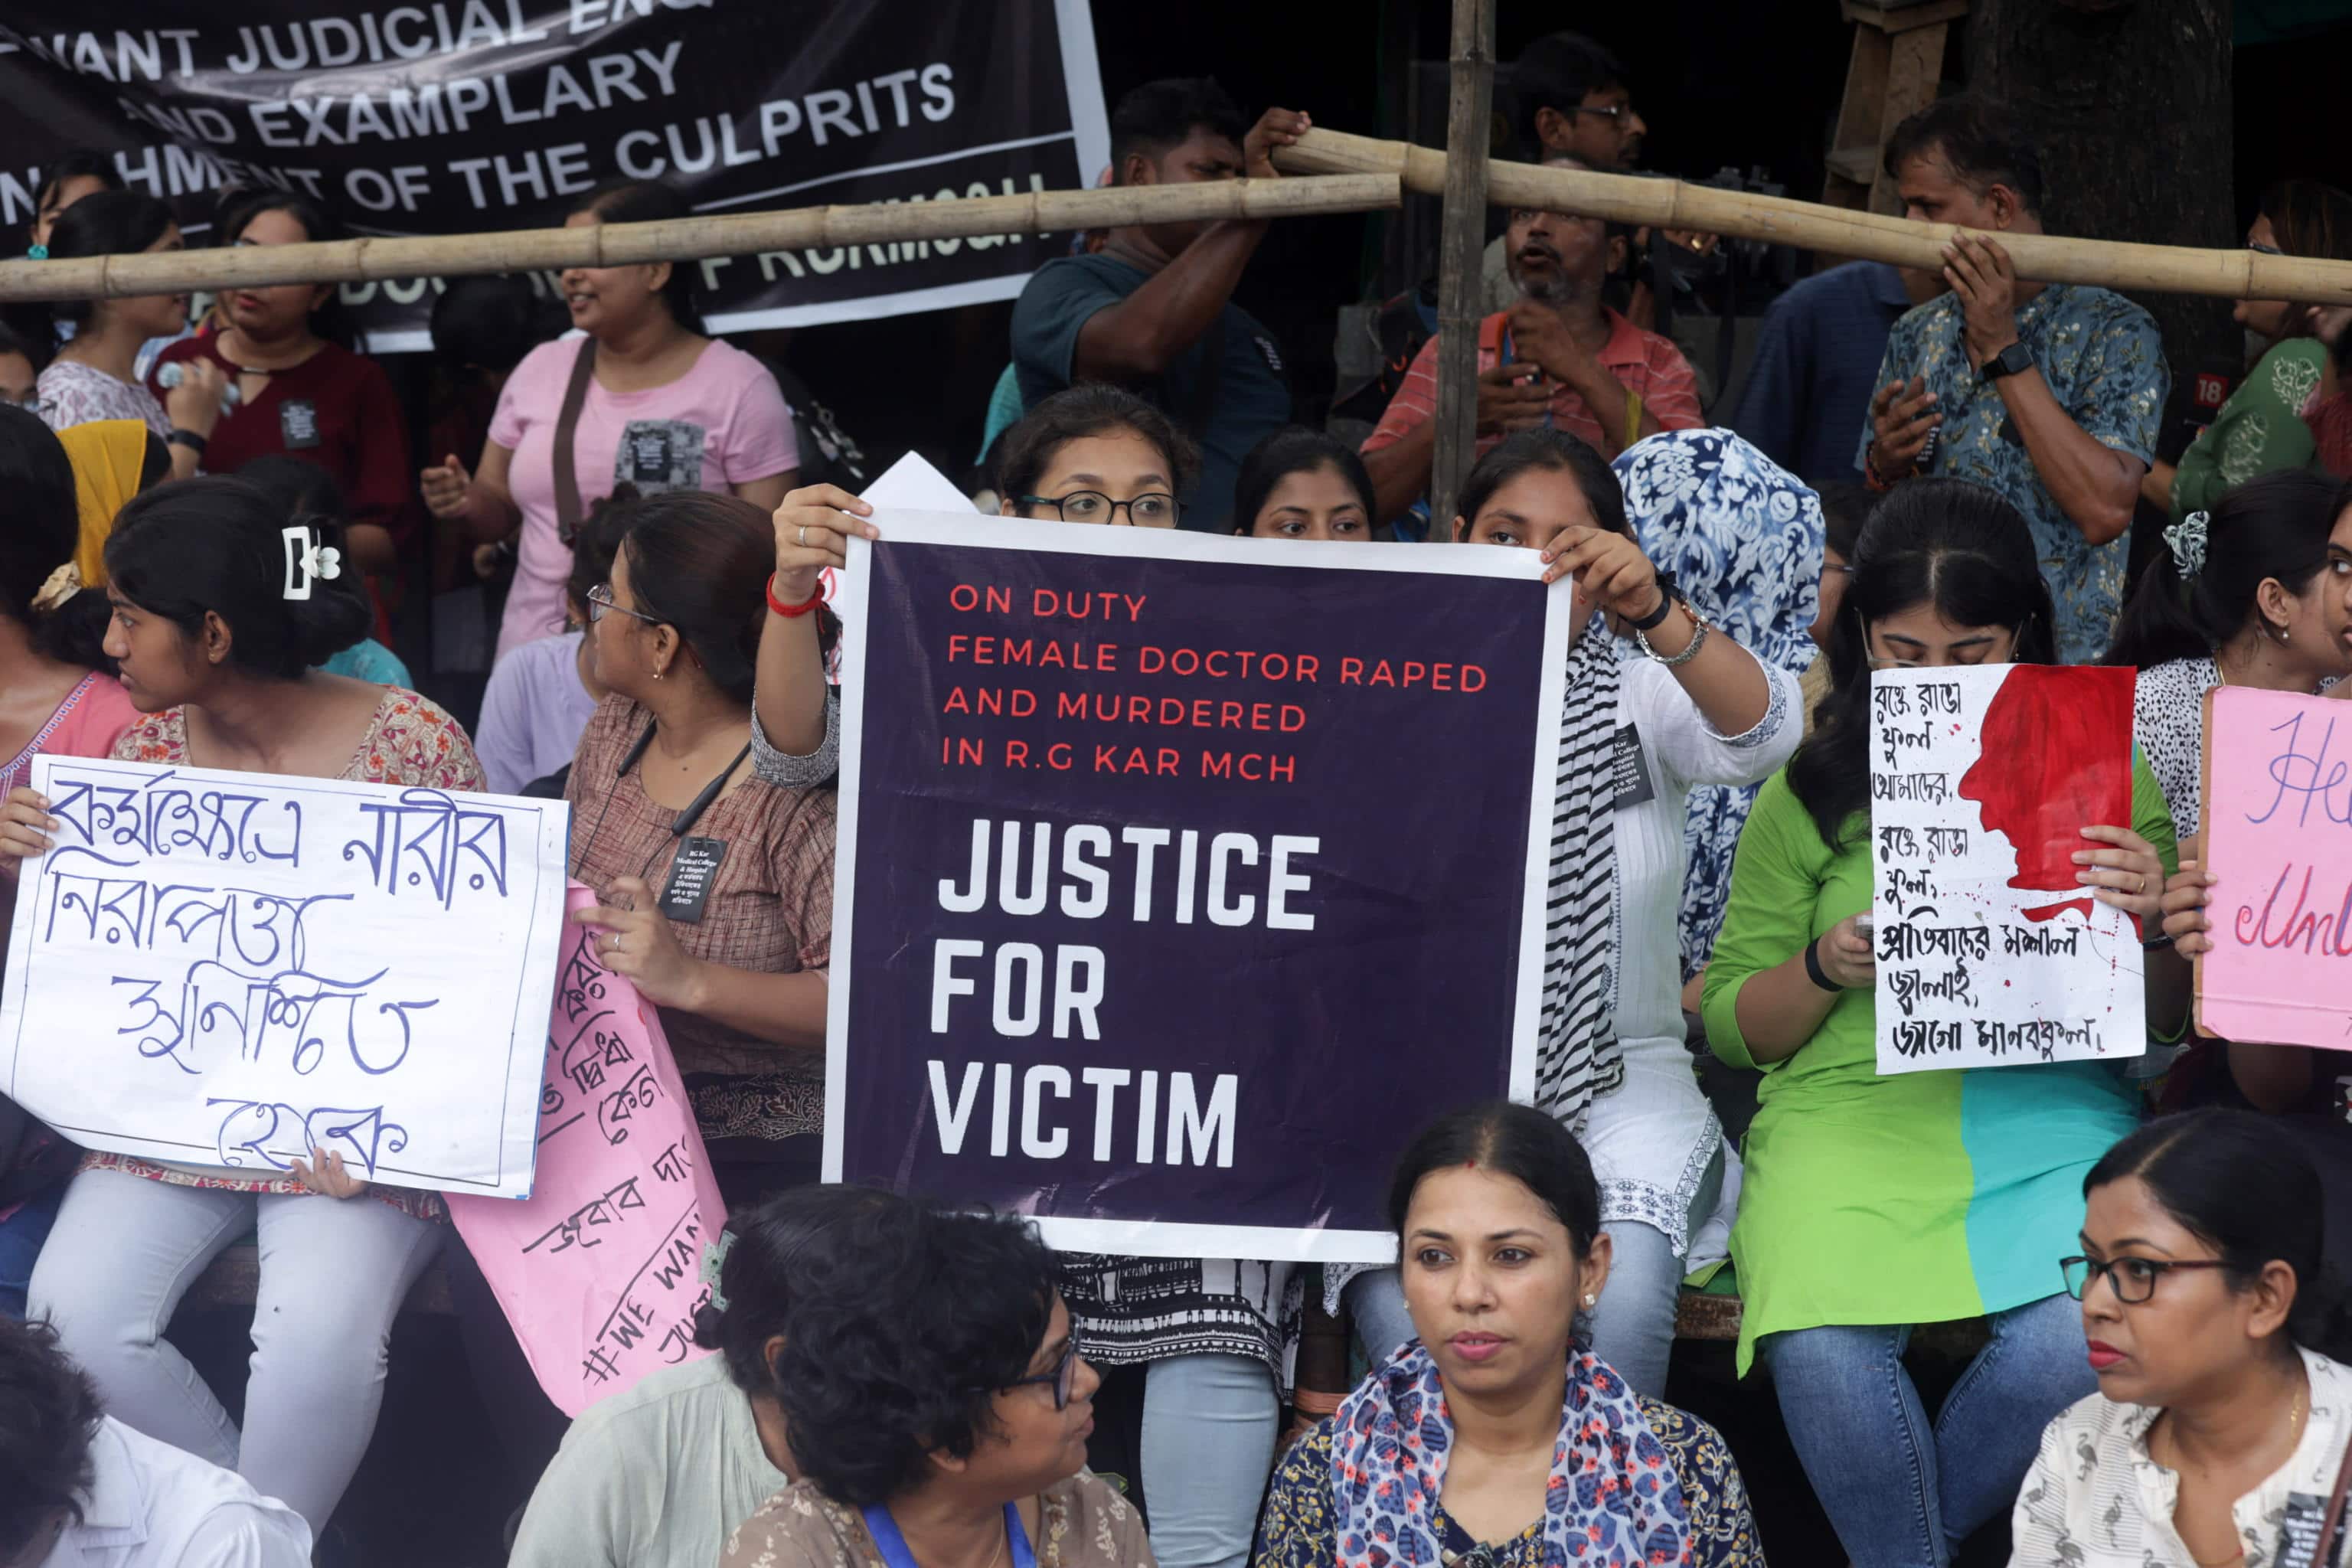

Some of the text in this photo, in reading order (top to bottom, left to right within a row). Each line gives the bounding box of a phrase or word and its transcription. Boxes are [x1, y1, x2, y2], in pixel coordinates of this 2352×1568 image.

[227, 0, 548, 74] JUDICIAL
[249, 41, 682, 148] EXAMPLARY
[345, 165, 430, 211] OF
[449, 142, 597, 211] THE
[615, 63, 956, 176] CULPRITS
[2199, 379, 2223, 403] 18
[951, 585, 1145, 621] ON DUTY
[944, 687, 1305, 731] AND MURDERED
[949, 635, 1486, 692] FEMALE DOCTOR RAPED
[943, 738, 1295, 782] IN R.G KAR MCH
[2245, 710, 2352, 828] He
[342, 788, 508, 910] নারীর
[939, 819, 1319, 929] JUSTICE
[932, 939, 1105, 1040] FOR
[207, 1098, 409, 1180] হোক
[928, 1060, 1237, 1167] VICTIM
